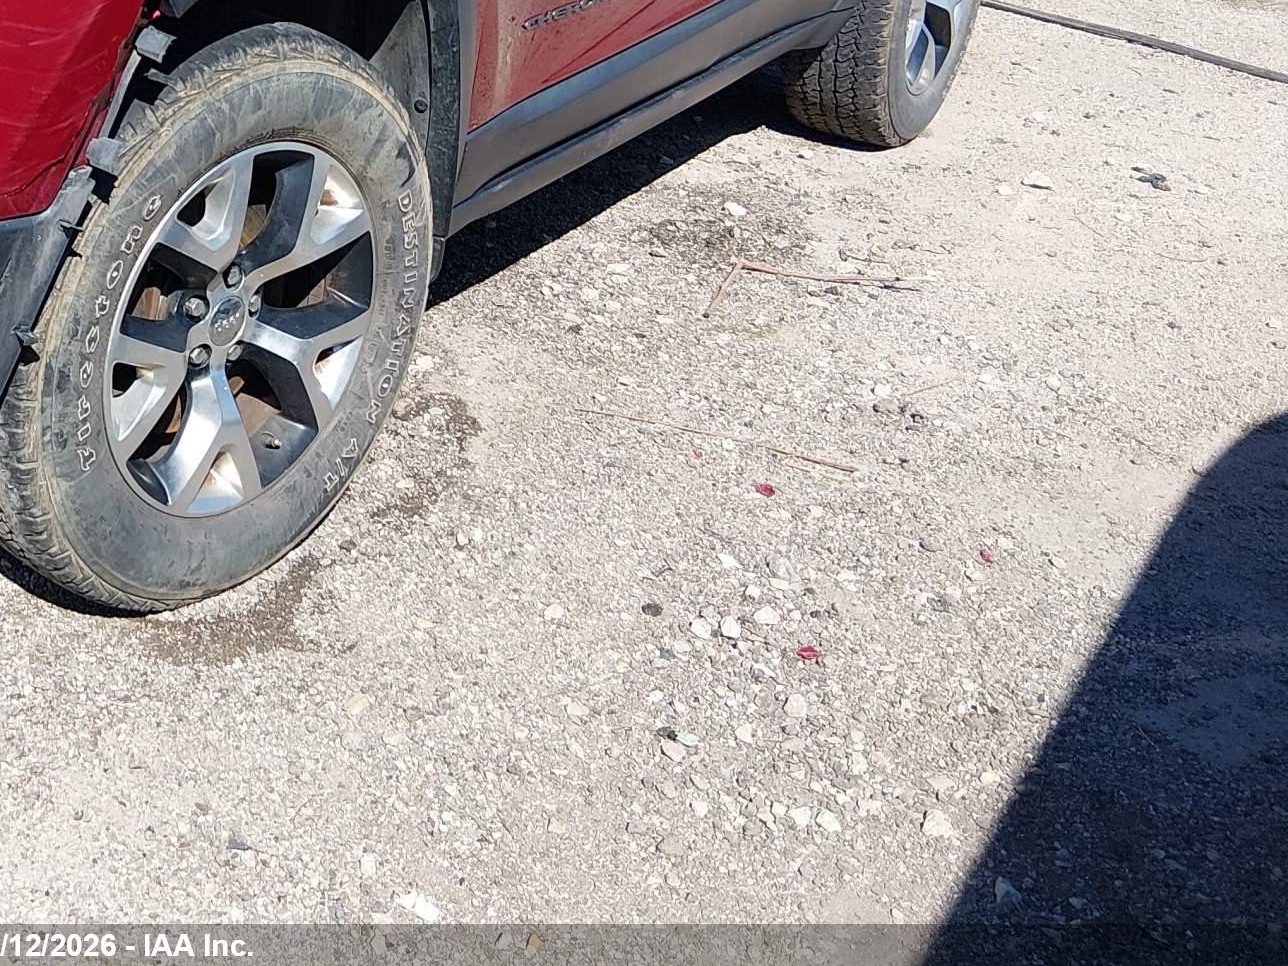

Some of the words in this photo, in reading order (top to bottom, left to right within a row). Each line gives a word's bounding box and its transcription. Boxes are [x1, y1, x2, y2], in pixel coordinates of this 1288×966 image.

[75, 194, 163, 474] Firestone
[364, 189, 421, 424] DESTINATION
[323, 437, 359, 493] A/T
